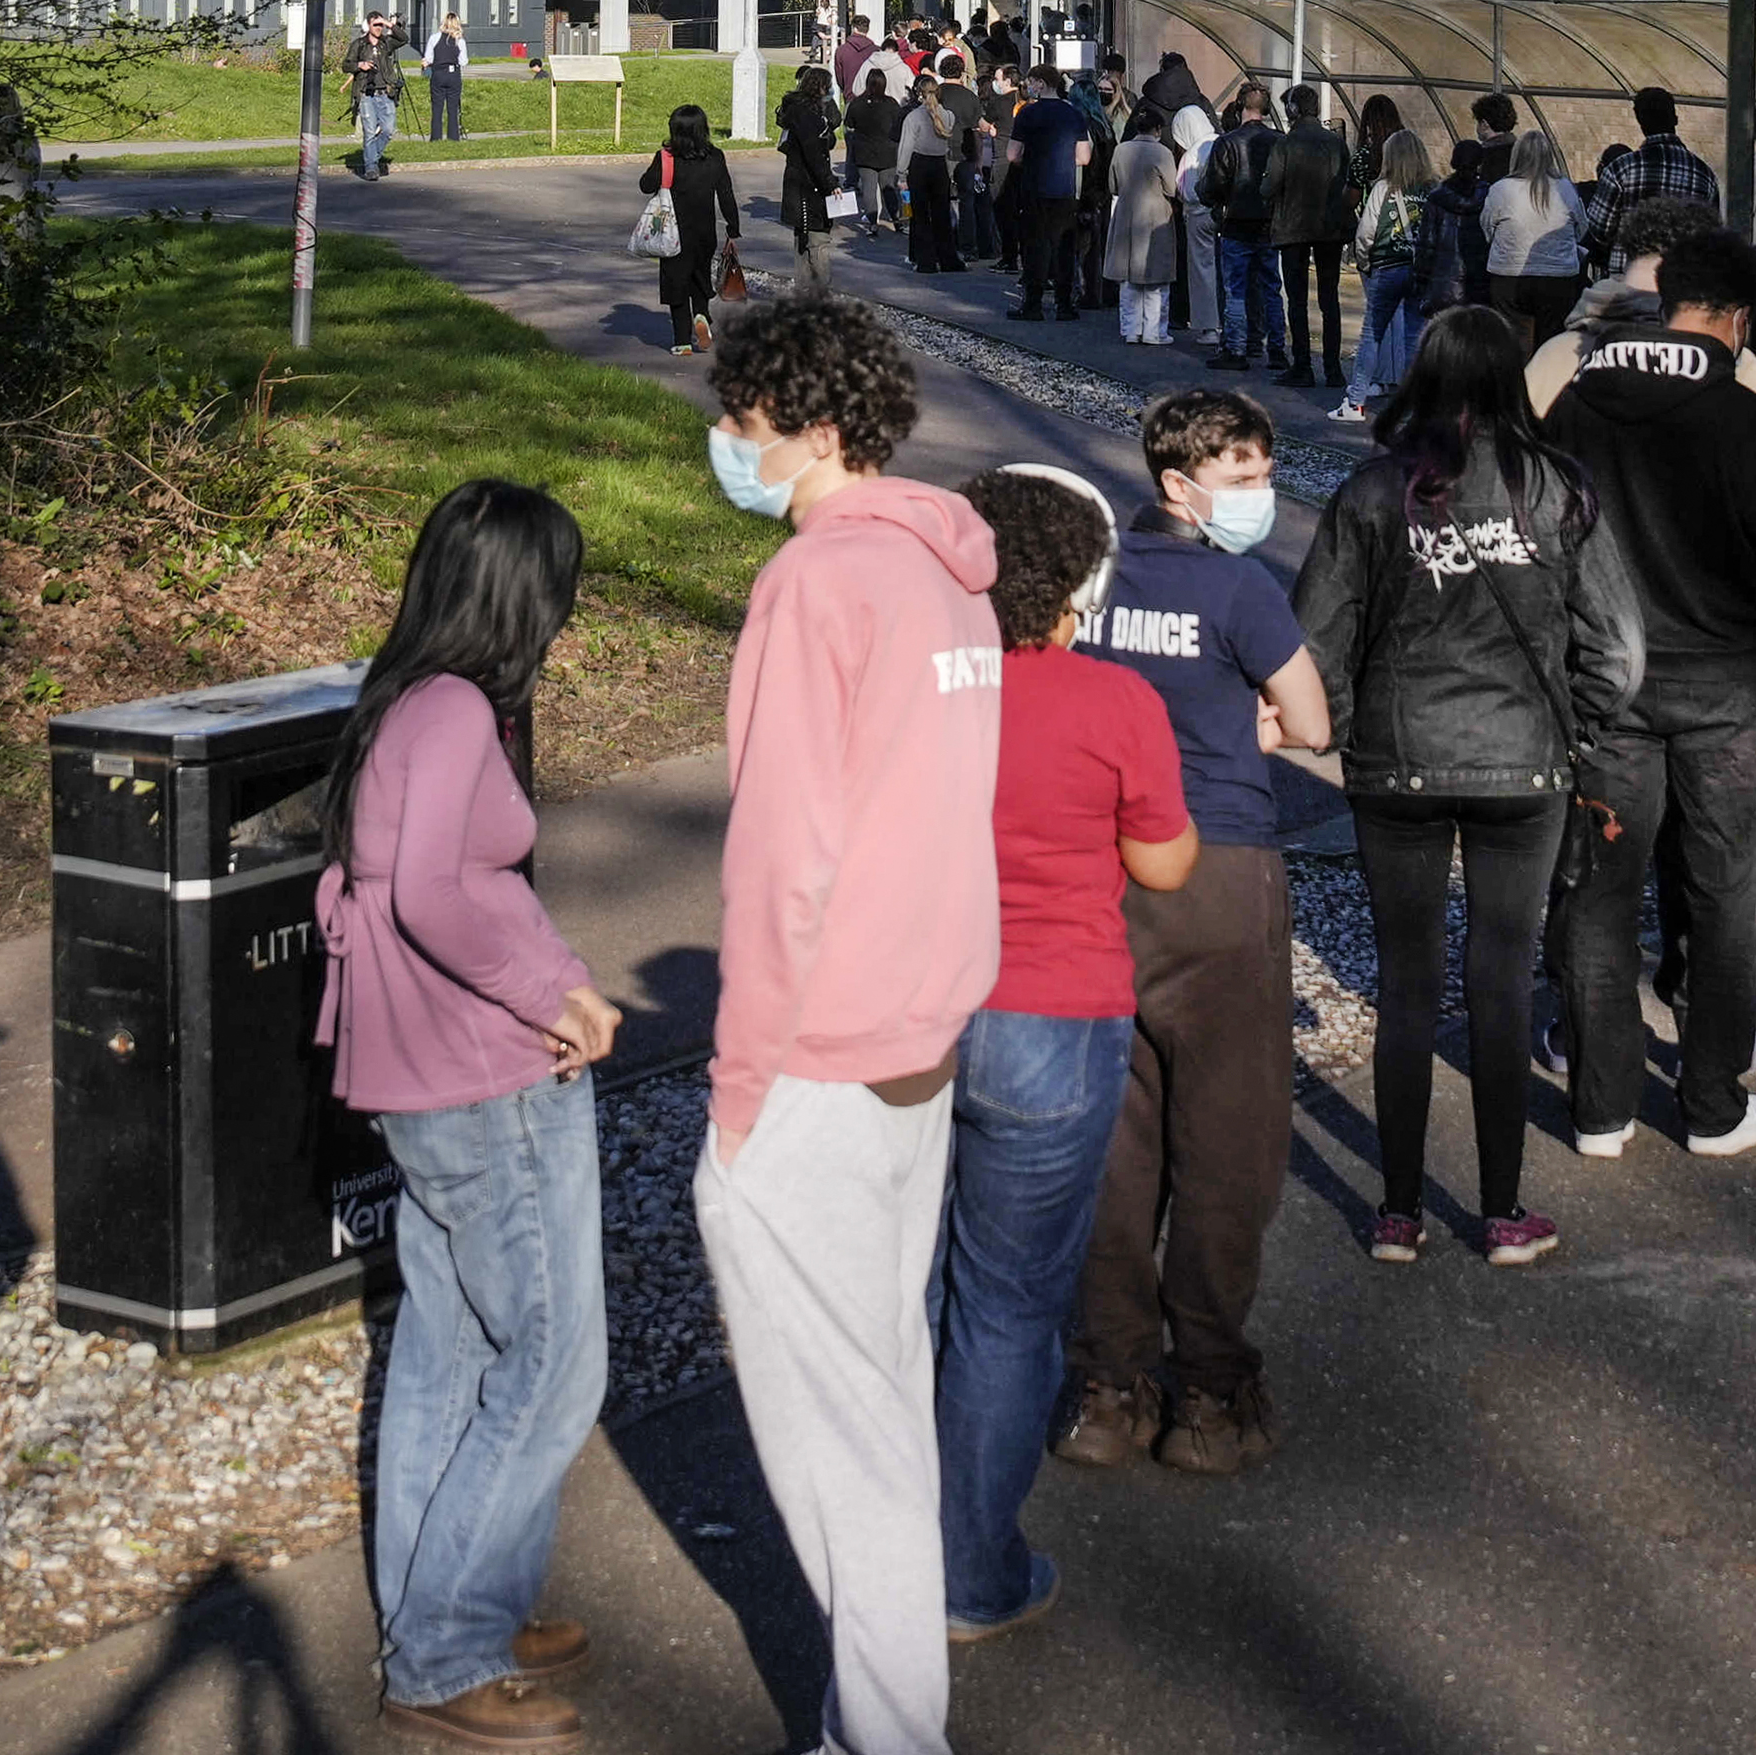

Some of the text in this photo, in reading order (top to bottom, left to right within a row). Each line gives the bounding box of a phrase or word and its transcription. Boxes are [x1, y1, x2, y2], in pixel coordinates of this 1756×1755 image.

[1111, 606, 1201, 658] DANCE
[252, 921, 312, 970] LITT
[332, 1161, 401, 1200] University
[331, 1196, 399, 1258] Ken
